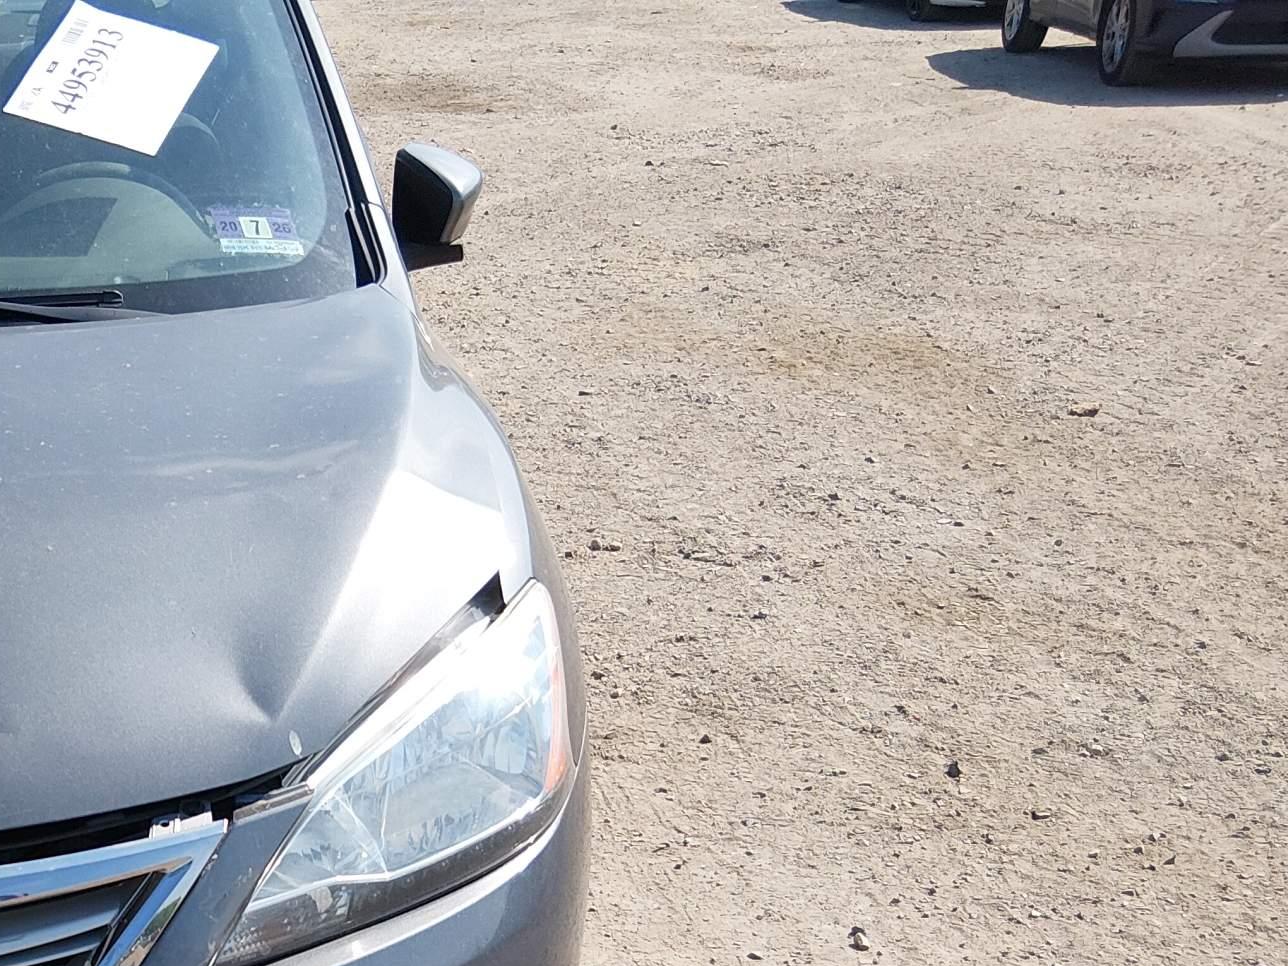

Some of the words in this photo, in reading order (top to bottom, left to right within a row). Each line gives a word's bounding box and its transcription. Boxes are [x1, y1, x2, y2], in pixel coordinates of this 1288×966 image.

[50, 28, 125, 115] 44953913
[219, 221, 238, 232] 20
[249, 219, 261, 236] 7
